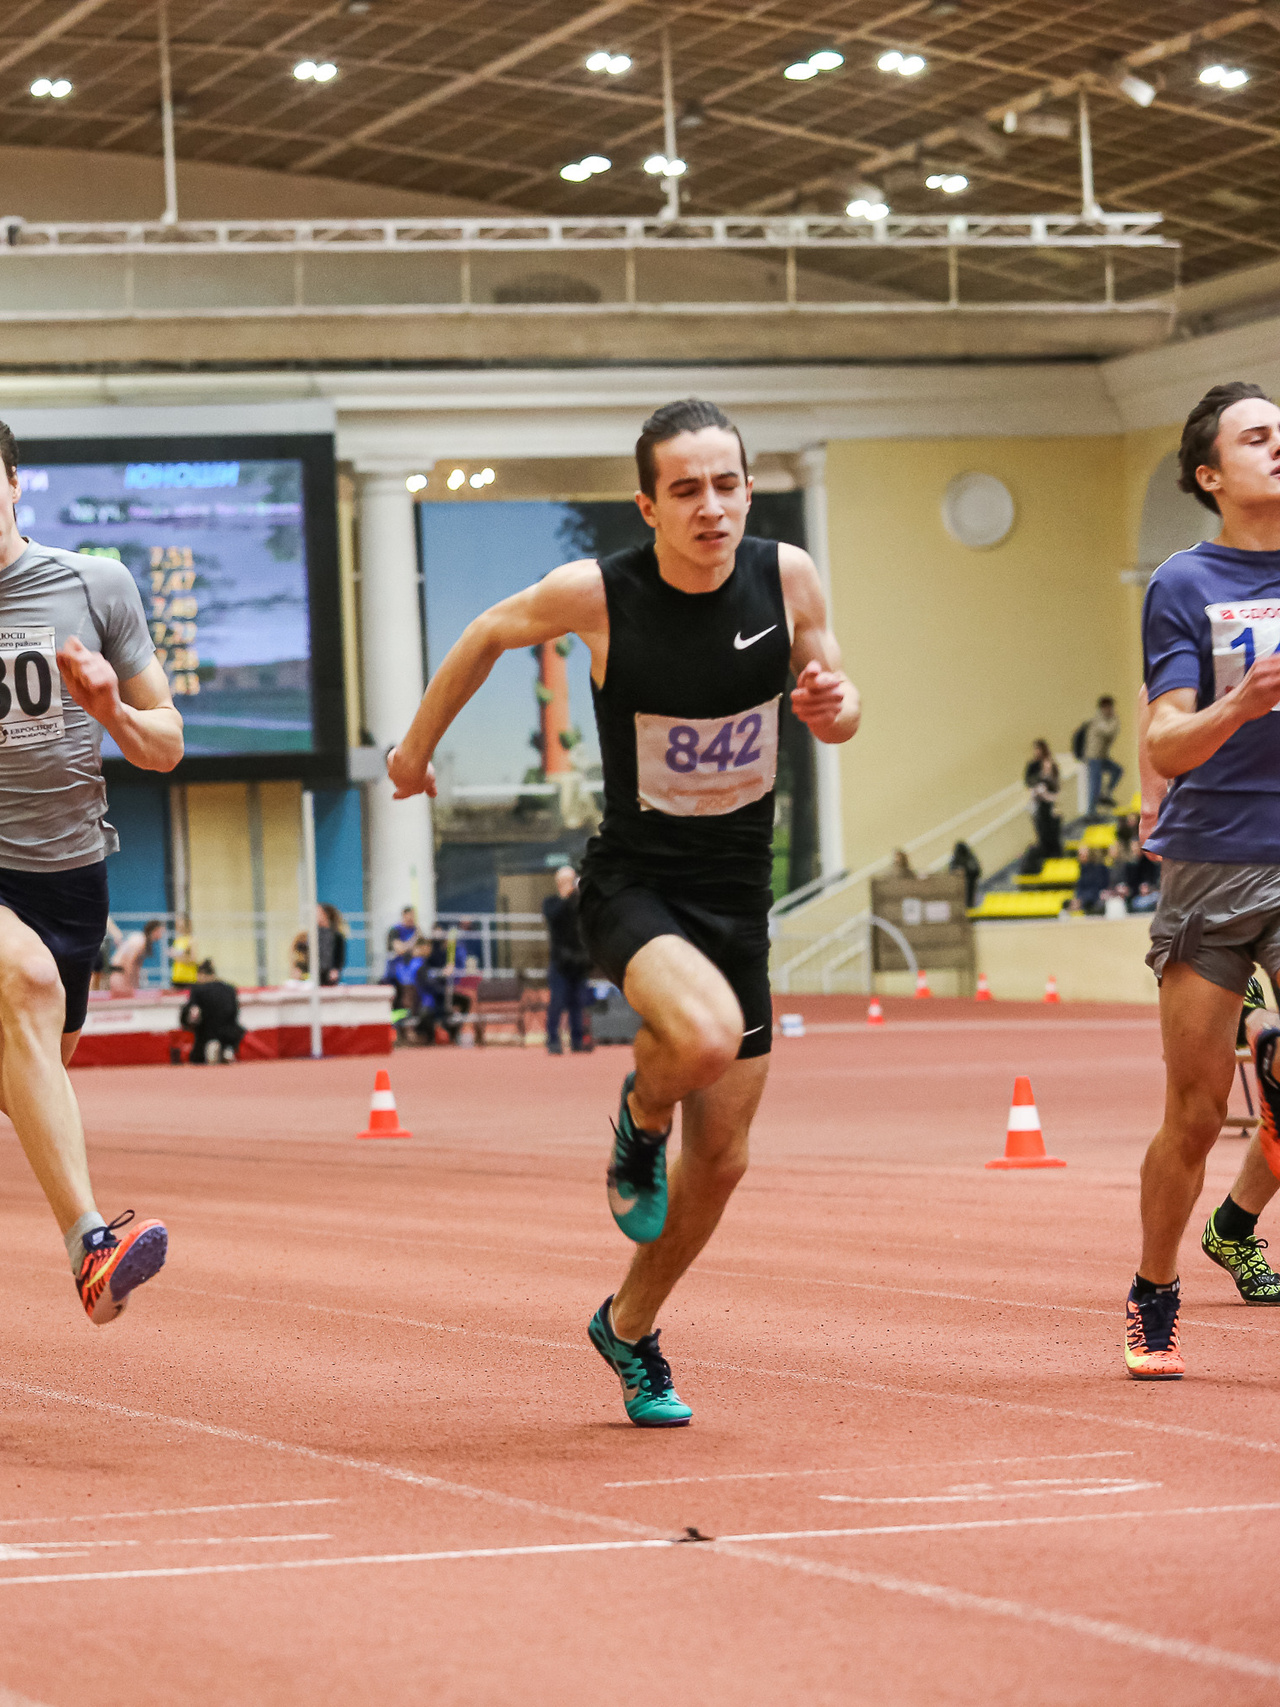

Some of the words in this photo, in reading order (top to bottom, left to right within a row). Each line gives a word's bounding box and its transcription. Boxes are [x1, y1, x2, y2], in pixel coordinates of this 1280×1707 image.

[125, 462, 239, 489] ЮНОШИ
[1230, 628, 1280, 676] 1
[665, 713, 762, 774] 842
